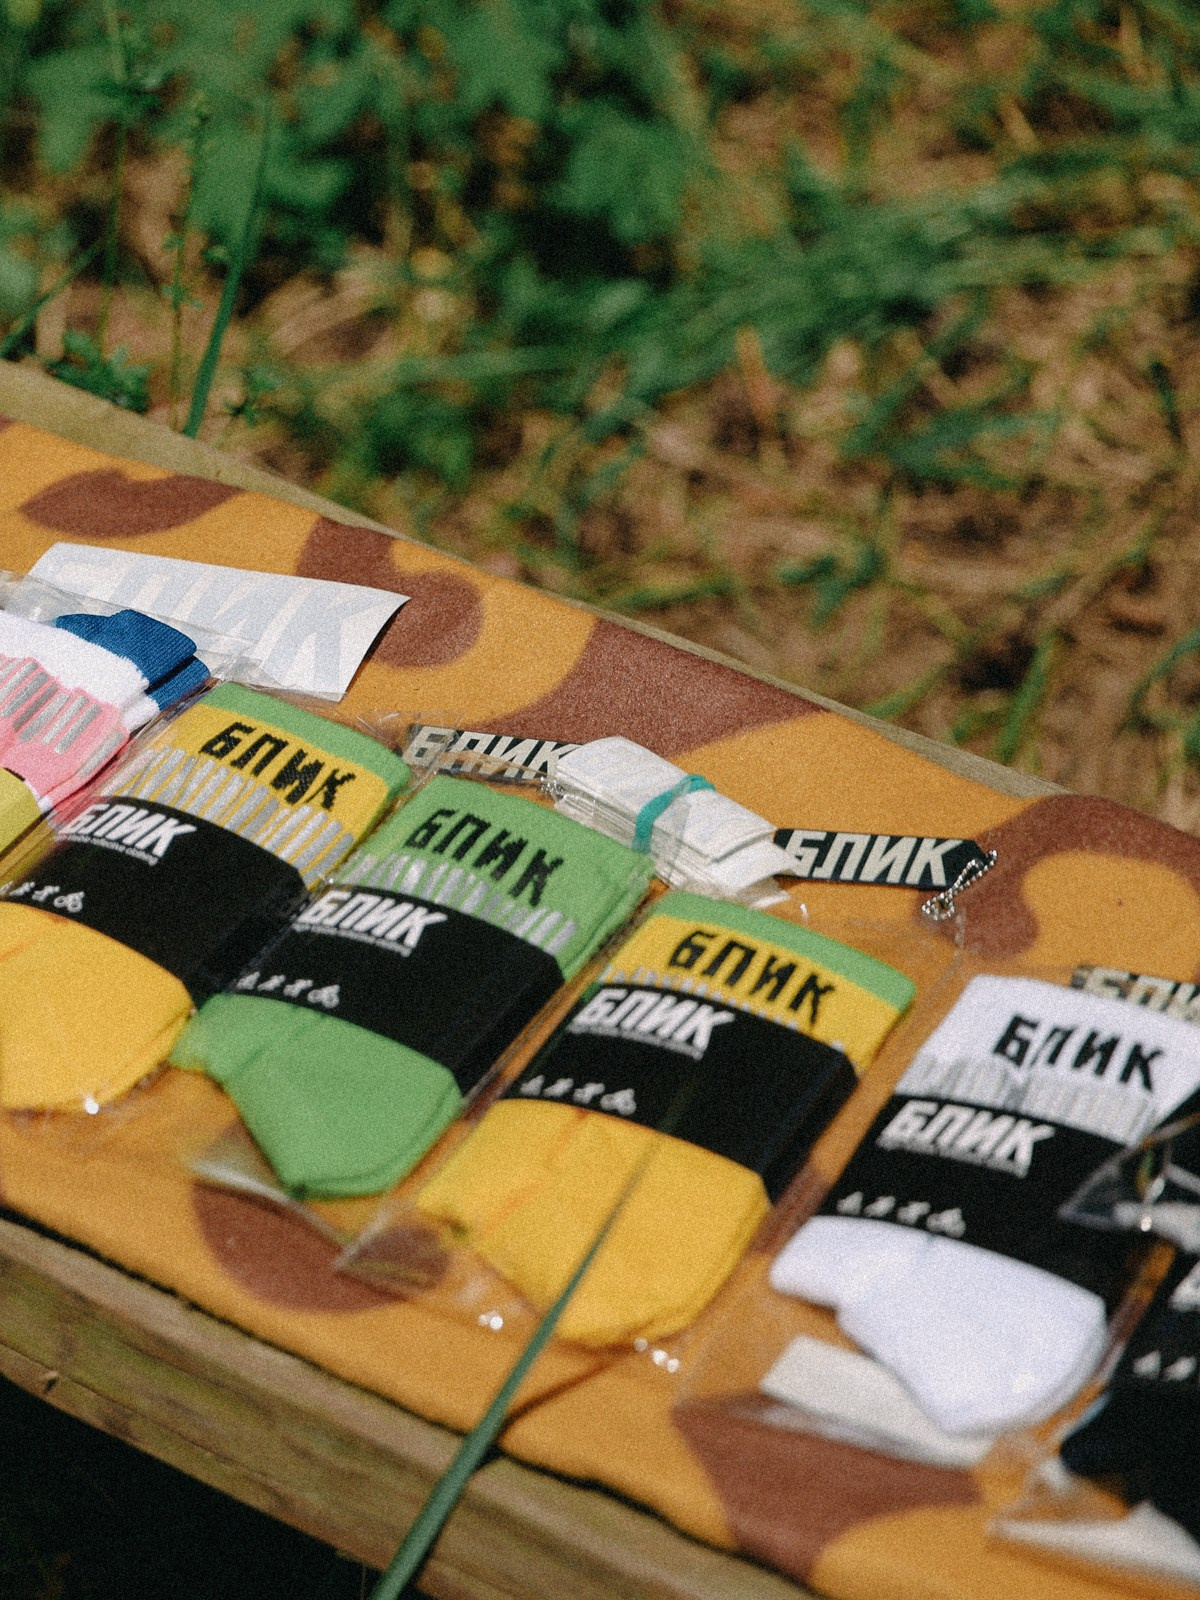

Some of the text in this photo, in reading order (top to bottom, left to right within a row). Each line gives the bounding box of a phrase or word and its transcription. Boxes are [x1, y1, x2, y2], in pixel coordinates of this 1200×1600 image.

[198, 721, 357, 812] БЛИК
[402, 725, 585, 783] БЛИК
[57, 803, 198, 858] БЛИК
[402, 808, 564, 907] БЛИК
[785, 829, 963, 886] БЛИК
[297, 889, 448, 949] БЛИК
[667, 929, 835, 1025] БЛИК
[572, 987, 736, 1052] БЛИК
[993, 1013, 1164, 1094] БЛИК
[879, 1100, 1056, 1174] БЛИК
